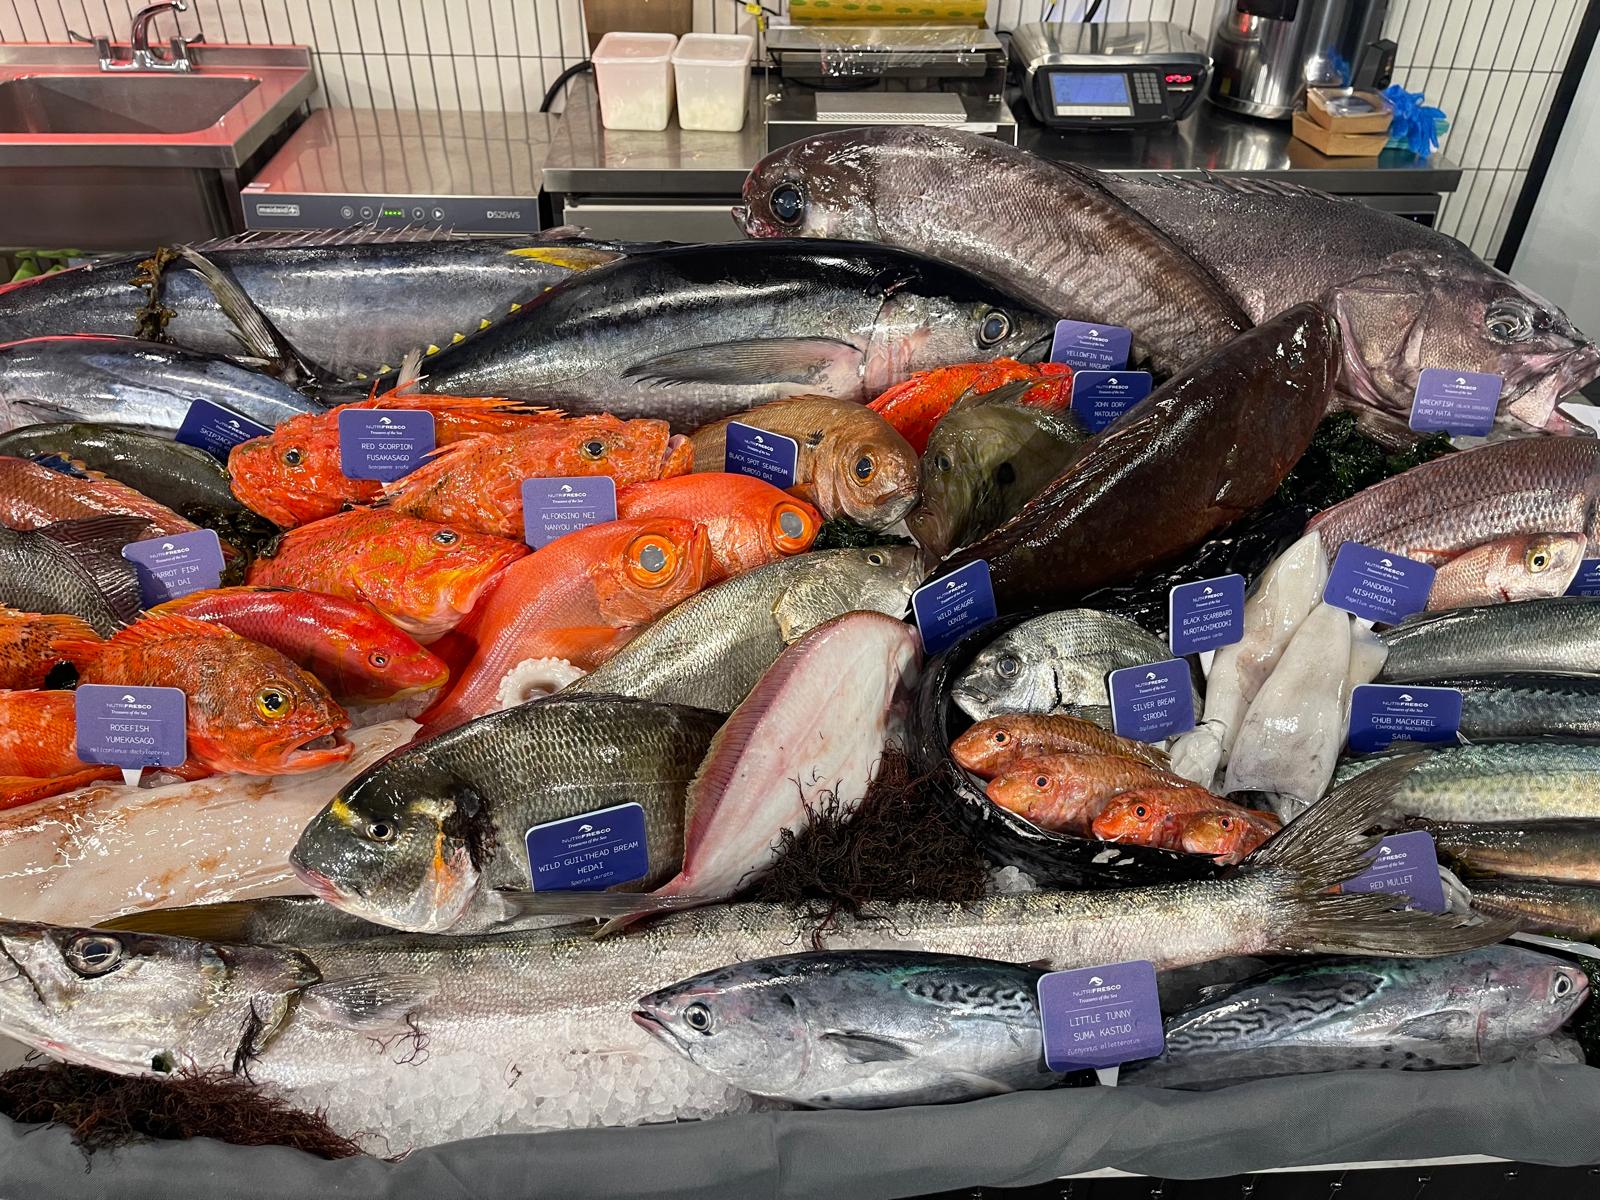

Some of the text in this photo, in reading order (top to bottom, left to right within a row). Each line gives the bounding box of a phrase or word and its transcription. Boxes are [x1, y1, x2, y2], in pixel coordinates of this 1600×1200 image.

[1066, 350, 1096, 359] YELLOWFIN
[1420, 399, 1454, 408] WRECKFISH
[200, 428, 232, 446] SKIPJACK
[729, 452, 788, 475] BLACK SPOT SEABREAM
[542, 512, 580, 520] ALFONSINO
[152, 565, 199, 579] PARROT FISH
[1365, 561, 1405, 576] NUTRIFRESCO
[177, 578, 190, 586] DAI
[1362, 580, 1393, 593] PANDORA
[1352, 587, 1396, 606] NISHIKIDAI
[937, 597, 974, 621] WILD MEAGRE
[1183, 617, 1200, 625] BLACK
[1132, 697, 1175, 712] SILVER BREAM
[110, 724, 149, 732] ROSEFISH
[1395, 718, 1436, 726] MACKEREL
[105, 736, 154, 744] YUMEKASAGO
[562, 828, 611, 844] NUTRIFRESCO
[538, 841, 639, 873] WILD GUILTHEAD BREAM
[577, 861, 604, 875] HEDAI
[1370, 875, 1413, 890] RED MULLET
[1072, 984, 1121, 997] NUTRIFRESCO
[1069, 1009, 1132, 1027] LITTLE TUNNY
[1074, 1024, 1131, 1042] SUMA KASTUO
